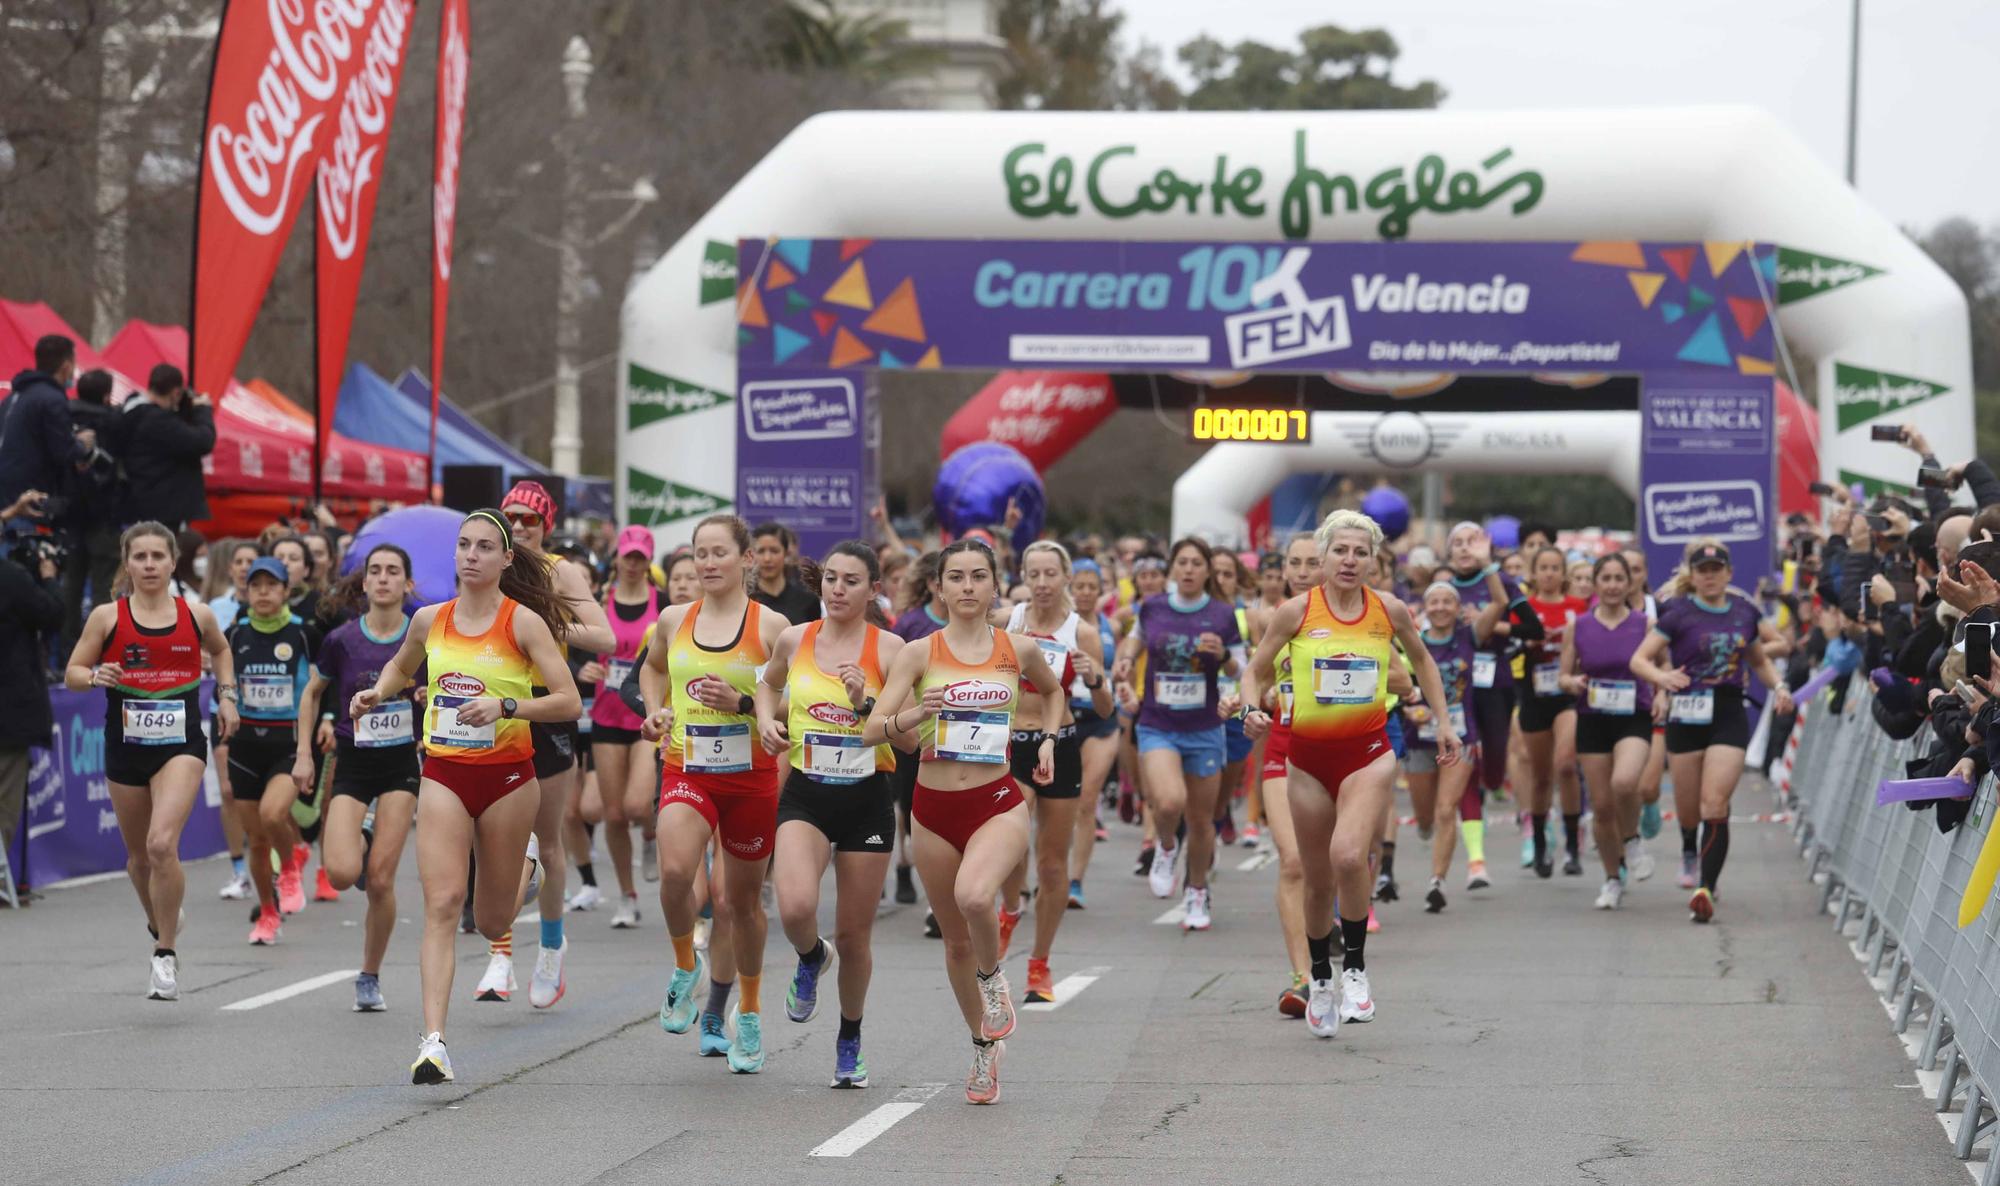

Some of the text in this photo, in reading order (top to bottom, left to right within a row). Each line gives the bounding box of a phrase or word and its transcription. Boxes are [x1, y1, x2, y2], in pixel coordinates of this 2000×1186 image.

[1003, 129, 1543, 240] El Corte Inglés
[974, 259, 1171, 309] Carrera
[1351, 272, 1531, 314] Valencia
[1240, 305, 1336, 359] FEM
[442, 679, 482, 692] Serrano
[1342, 672, 1352, 686] 3
[250, 687, 284, 699] 1676
[948, 689, 1009, 702] Serrano
[134, 713, 175, 728] 1649
[369, 713, 400, 730] 640
[814, 708, 855, 722] Serrano
[970, 725, 981, 741] 7
[713, 740, 723, 754] 5
[834, 750, 844, 765] 1
